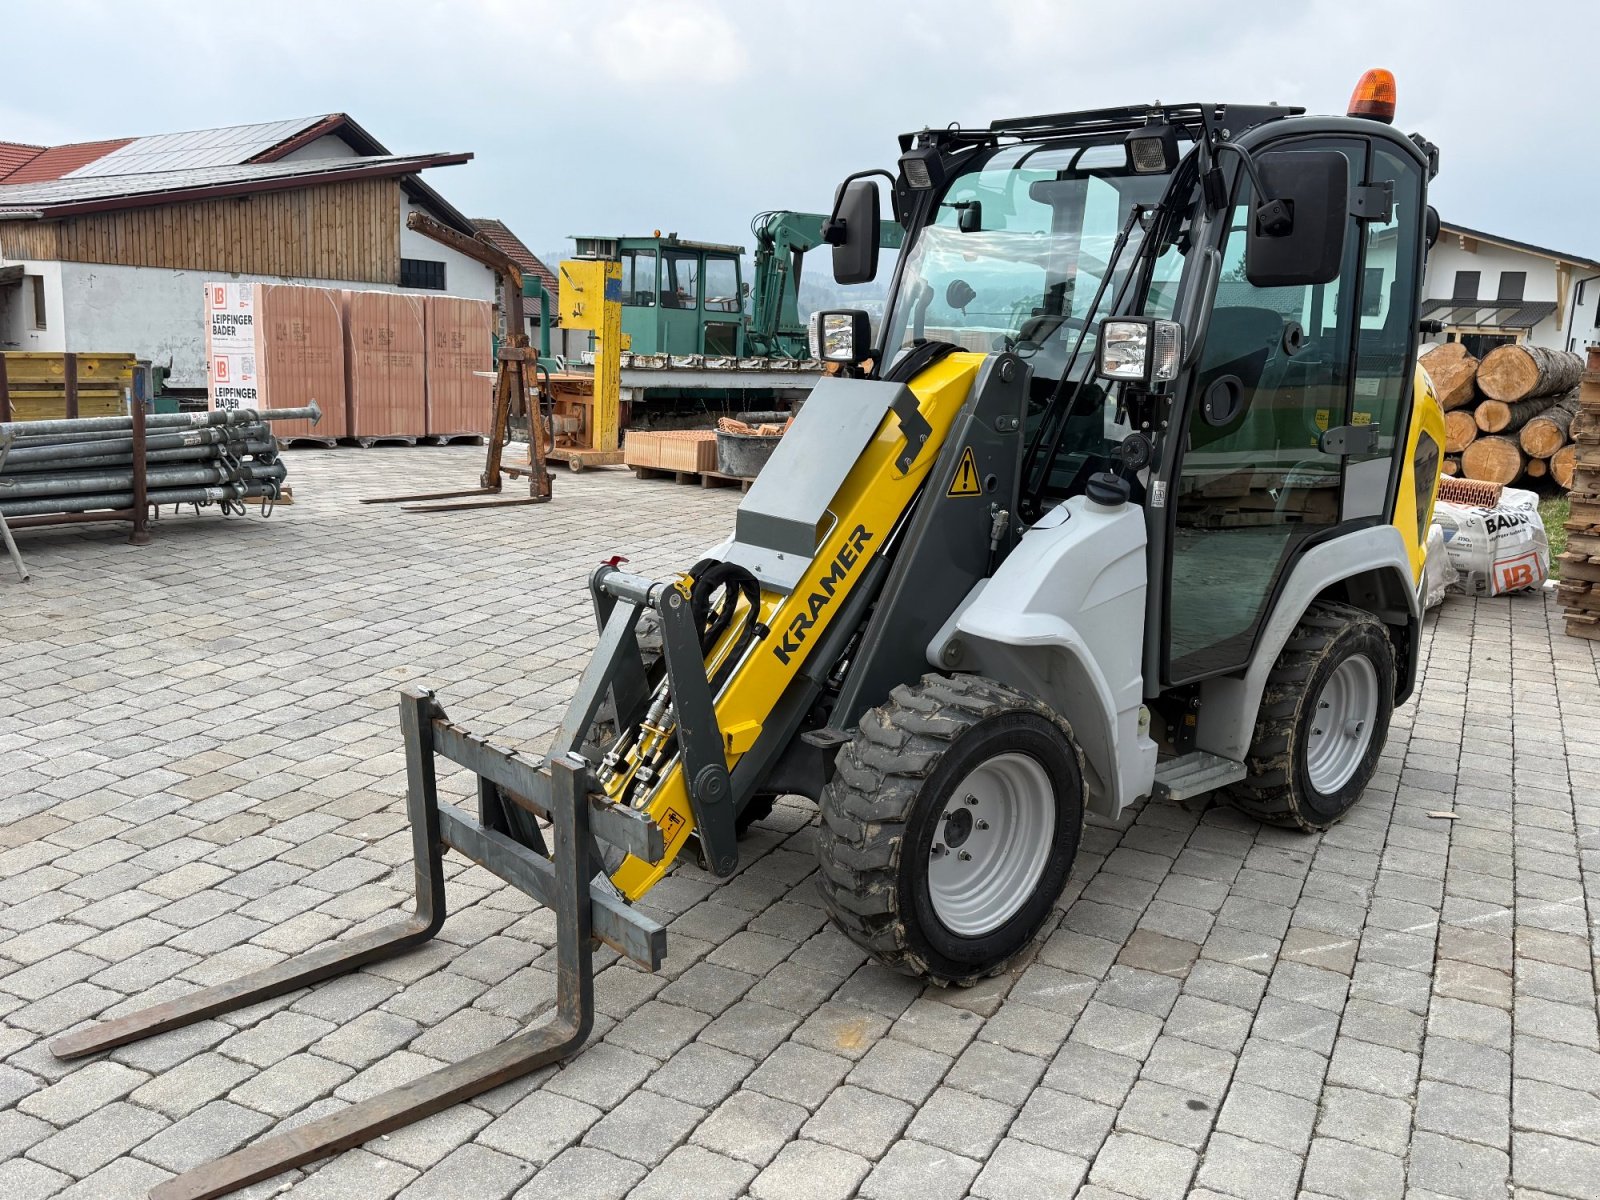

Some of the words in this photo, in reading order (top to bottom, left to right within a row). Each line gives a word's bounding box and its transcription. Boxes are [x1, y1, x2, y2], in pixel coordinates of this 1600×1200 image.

[212, 313, 253, 325] LEIPFINGER
[212, 324, 236, 336] BADER
[215, 387, 257, 399] LEIPFINGER
[215, 398, 240, 410] BADER
[772, 523, 874, 666] KRAMER
